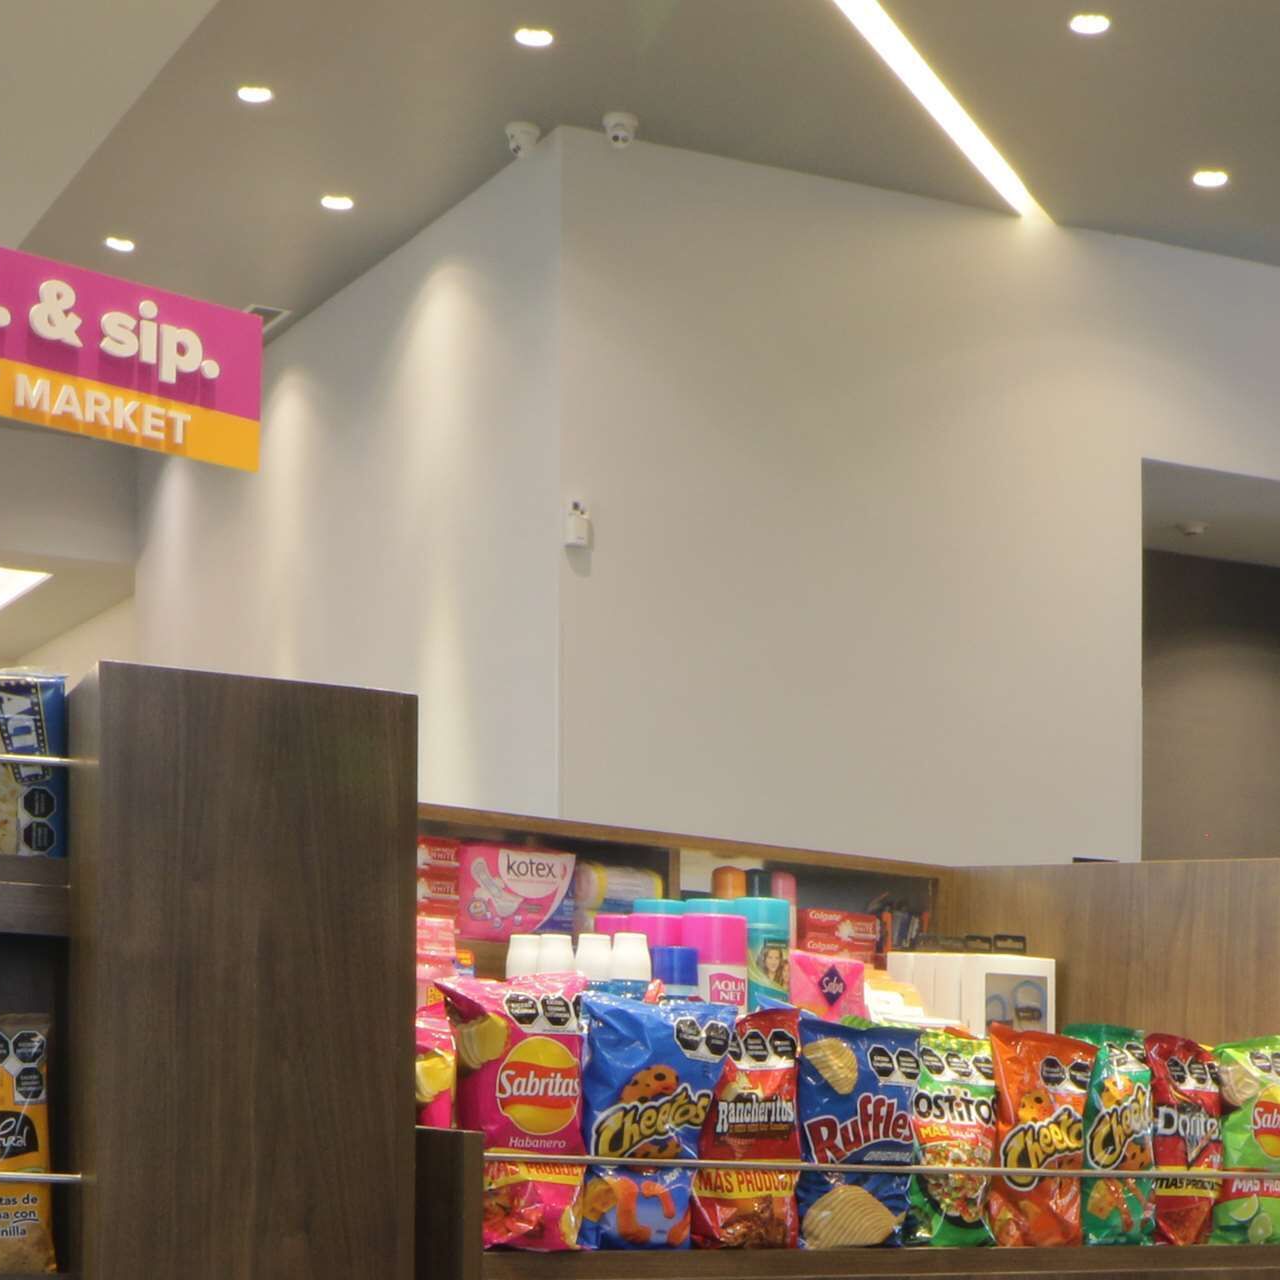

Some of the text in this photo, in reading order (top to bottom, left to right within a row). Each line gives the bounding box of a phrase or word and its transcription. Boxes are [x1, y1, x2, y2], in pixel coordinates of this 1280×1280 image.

[29, 279, 84, 348] &
[100, 300, 220, 384] sip.
[15, 374, 191, 444] MARKET
[507, 854, 556, 879] kotex
[711, 980, 745, 992] AQUA
[498, 1070, 579, 1099] Sabritas
[594, 1086, 712, 1161] Cheetos
[716, 1095, 795, 1132] Rancheritos
[508, 1137, 566, 1149] Habanero
[806, 1094, 913, 1165] Ruffles
[22, 1194, 38, 1205] de
[14, 1211, 36, 1220] con
